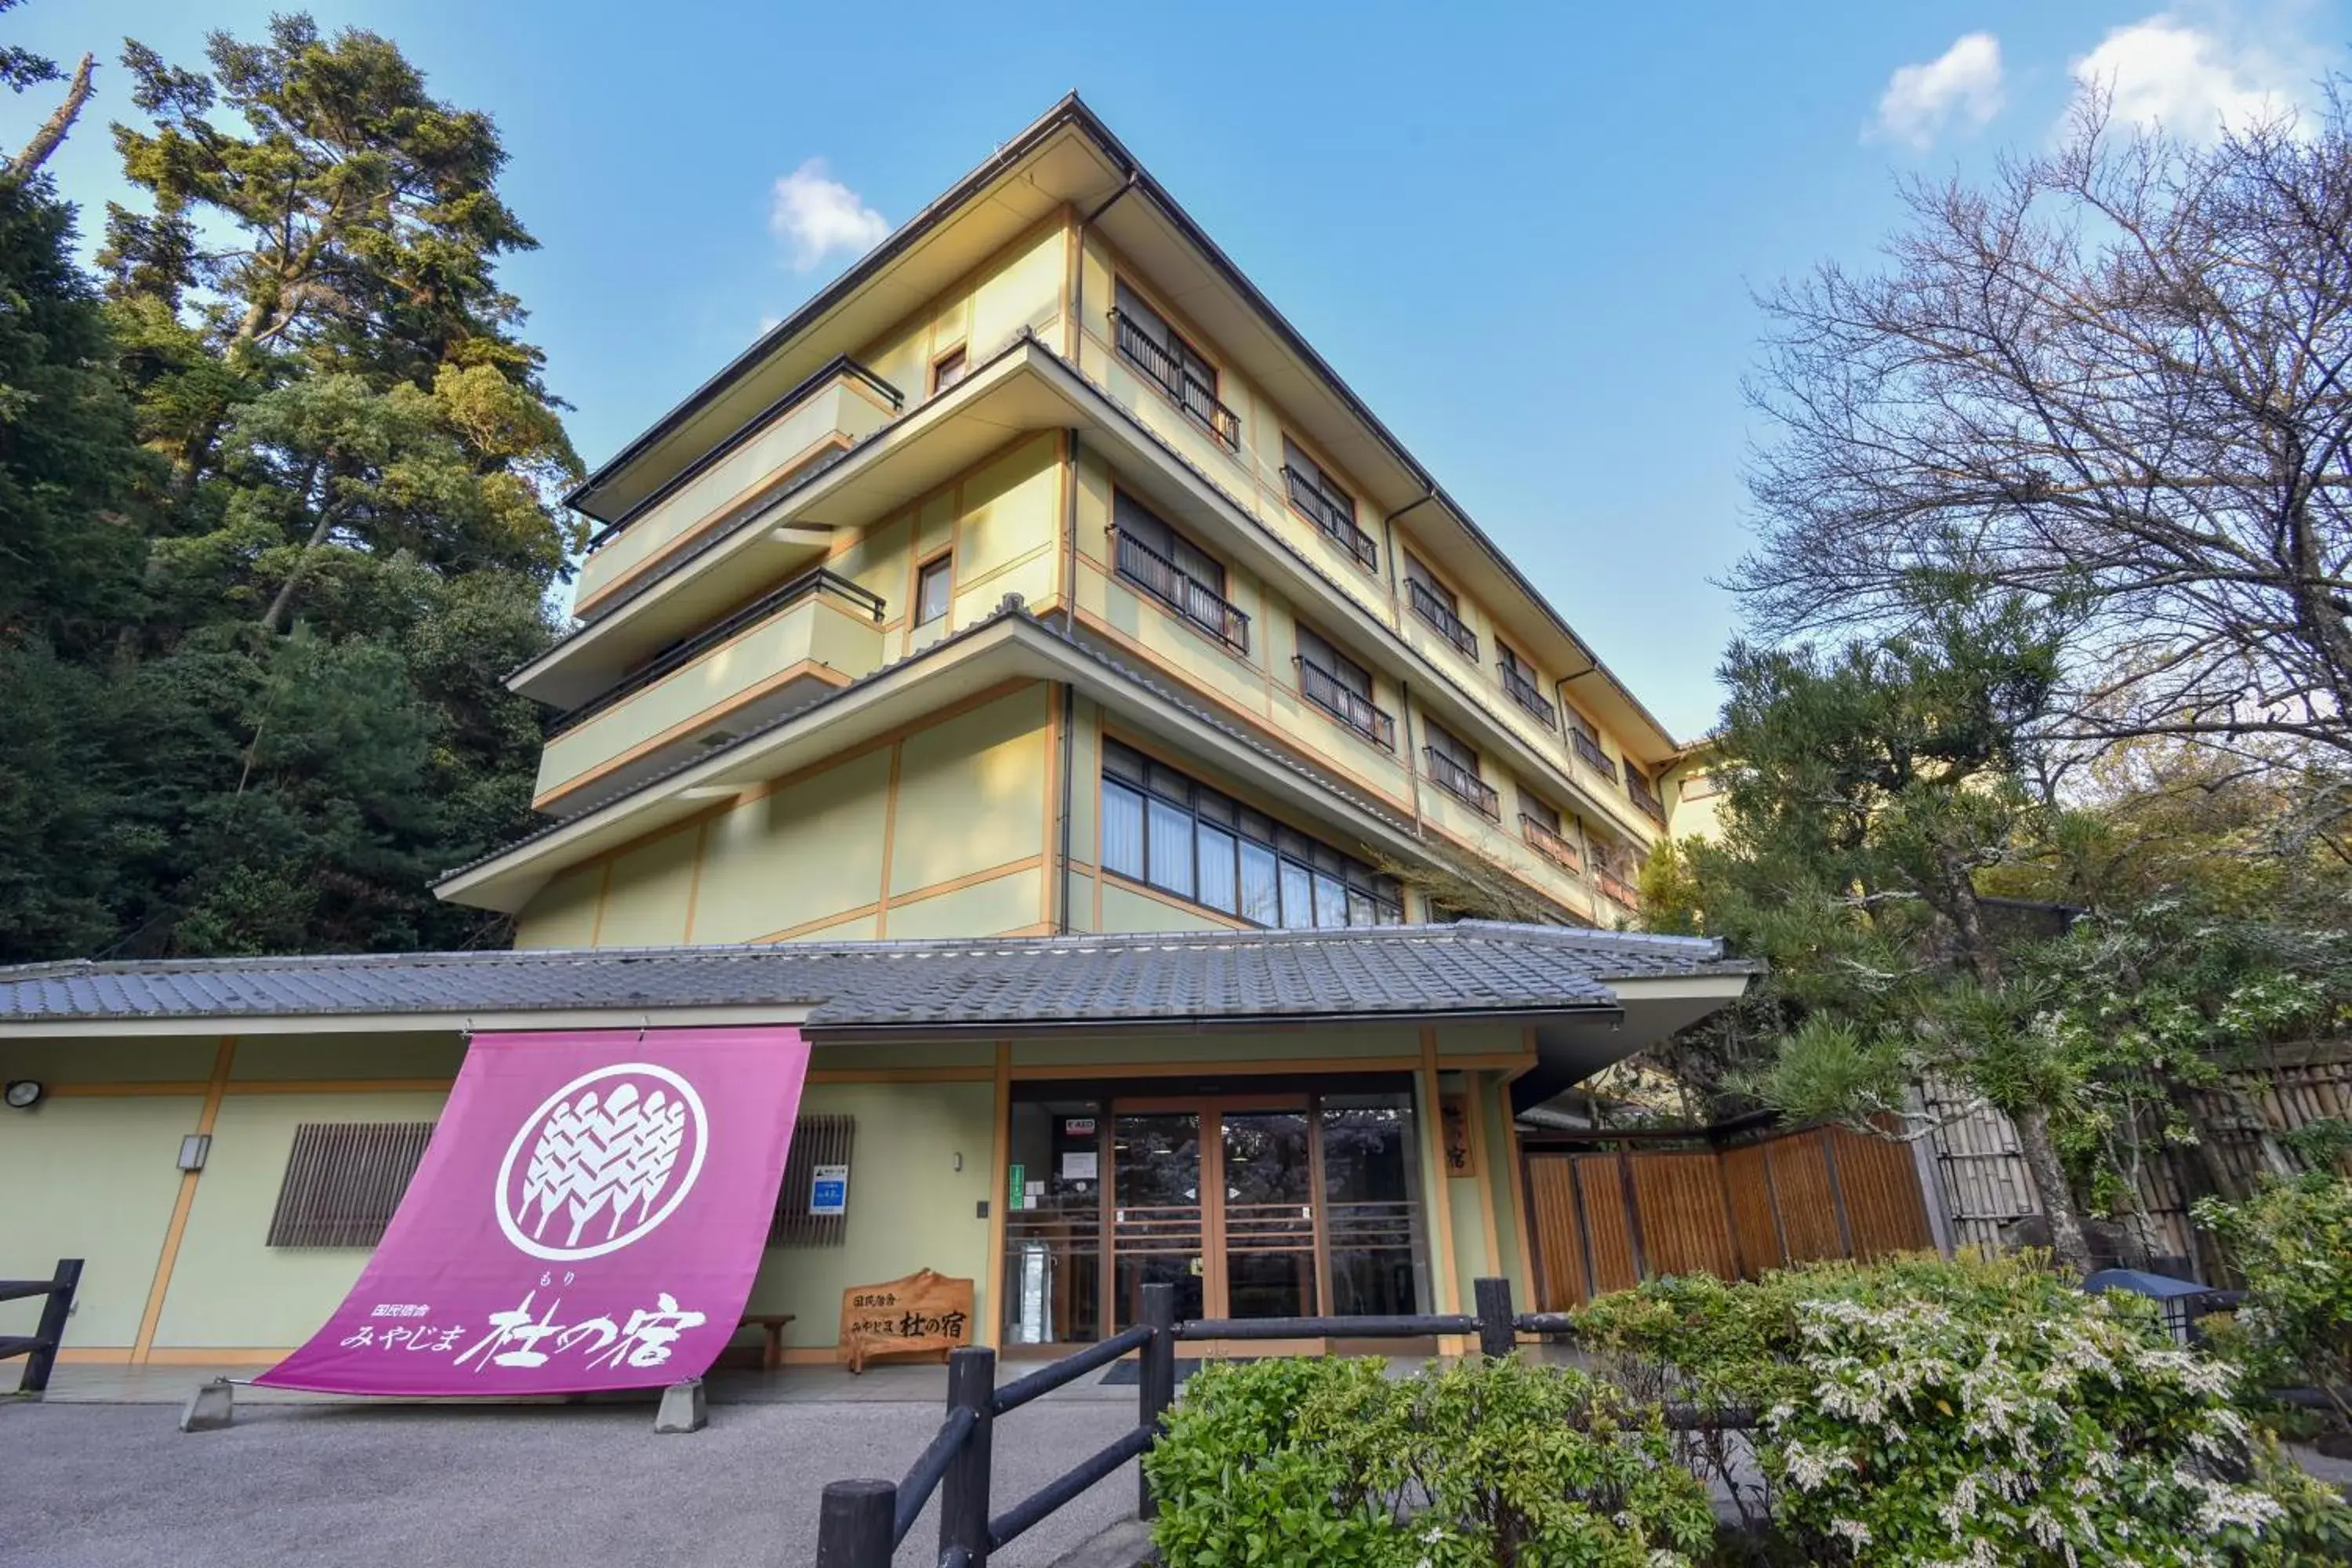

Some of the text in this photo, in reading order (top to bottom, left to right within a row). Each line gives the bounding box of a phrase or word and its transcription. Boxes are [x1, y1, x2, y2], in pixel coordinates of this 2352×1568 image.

[540, 1271, 575, 1287] もり
[371, 1304, 430, 1317] 国民宿舎
[340, 1290, 706, 1372] みやじま 杜の宿
